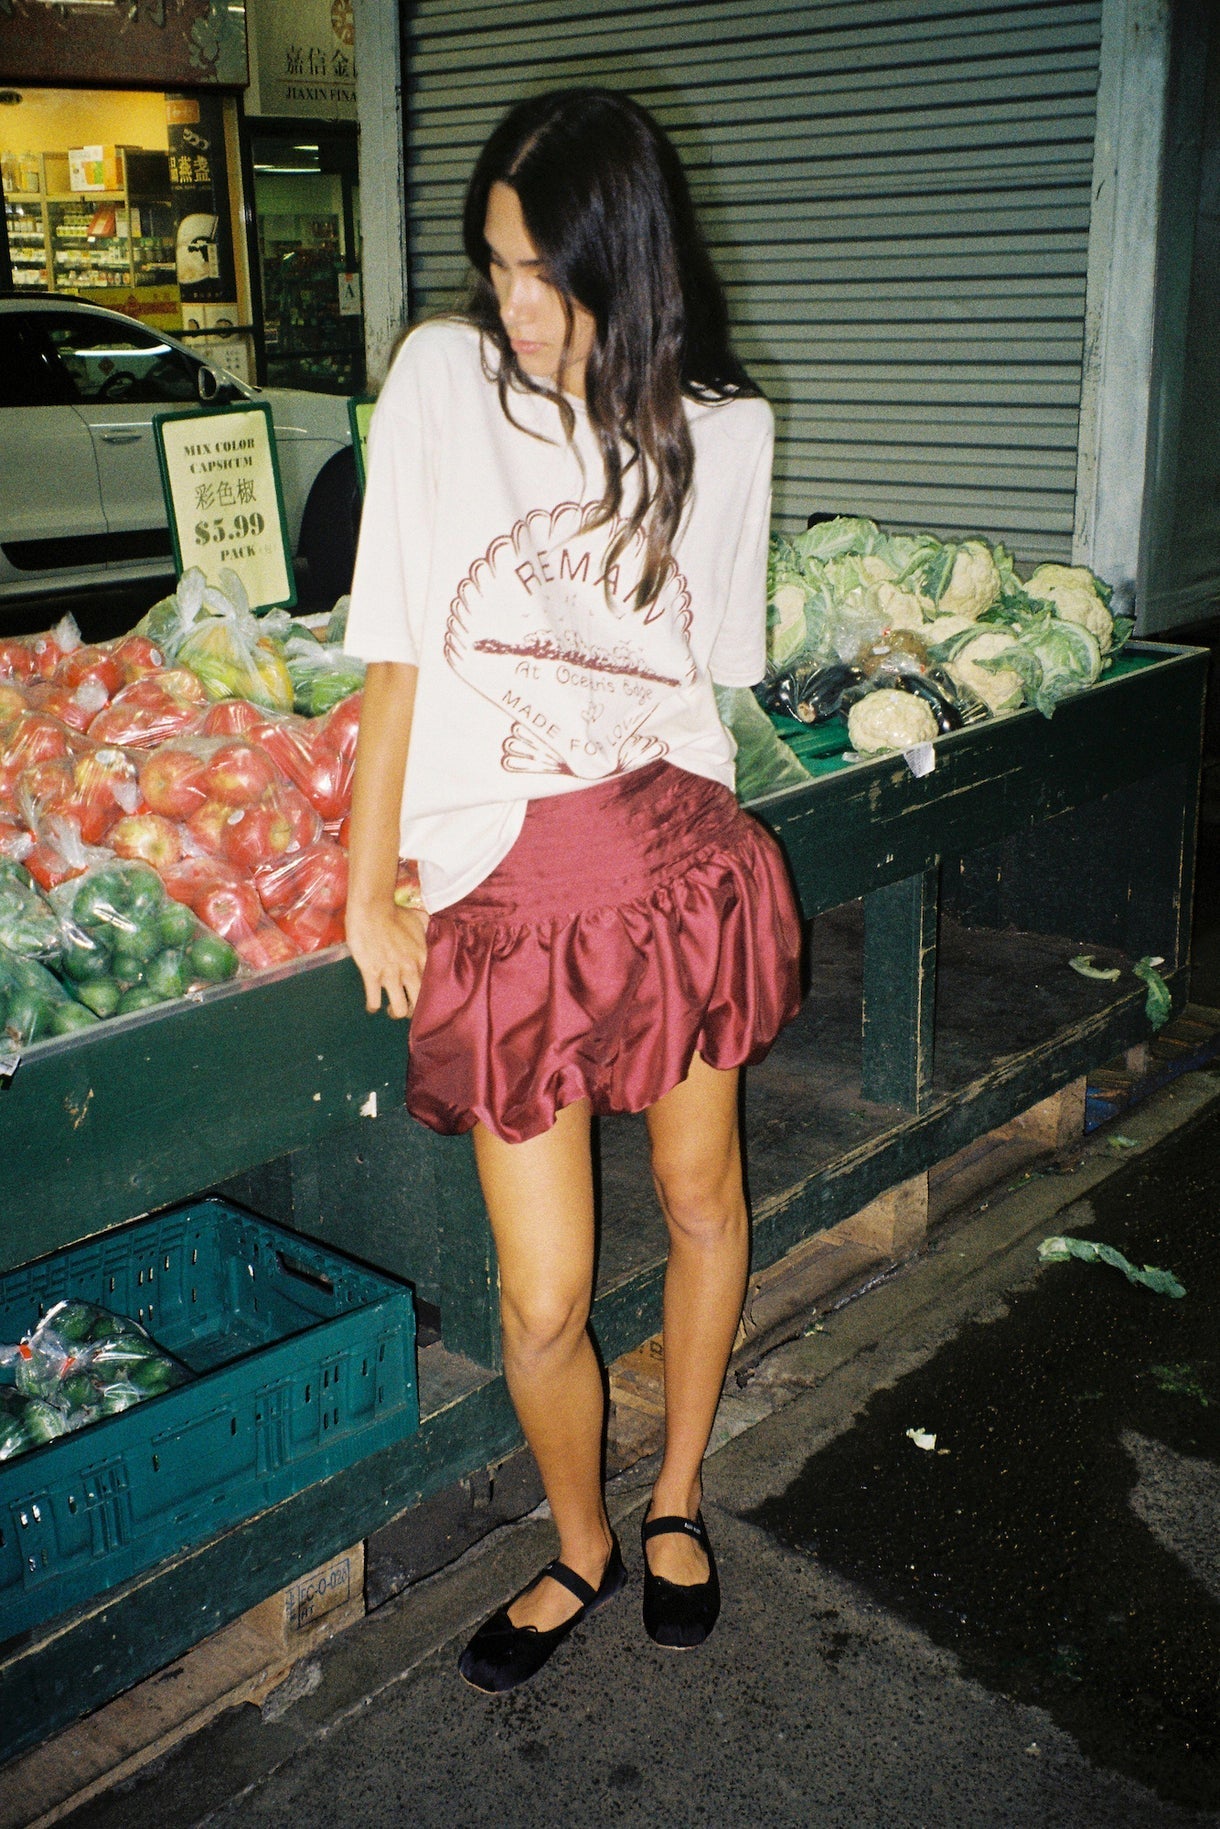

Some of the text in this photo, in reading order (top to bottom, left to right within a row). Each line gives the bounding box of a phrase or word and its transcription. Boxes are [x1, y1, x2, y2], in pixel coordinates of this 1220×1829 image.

[286, 46, 357, 78] 嘉信金
[286, 87, 327, 100] JIAXIN
[184, 438, 255, 457] MIX COLOR
[190, 456, 253, 475] CAPSICUM
[195, 478, 257, 510] 彩色椒
[194, 512, 265, 546] $5.99
[220, 548, 256, 562] PACK
[515, 660, 540, 680] At
[501, 689, 561, 739] MADE
